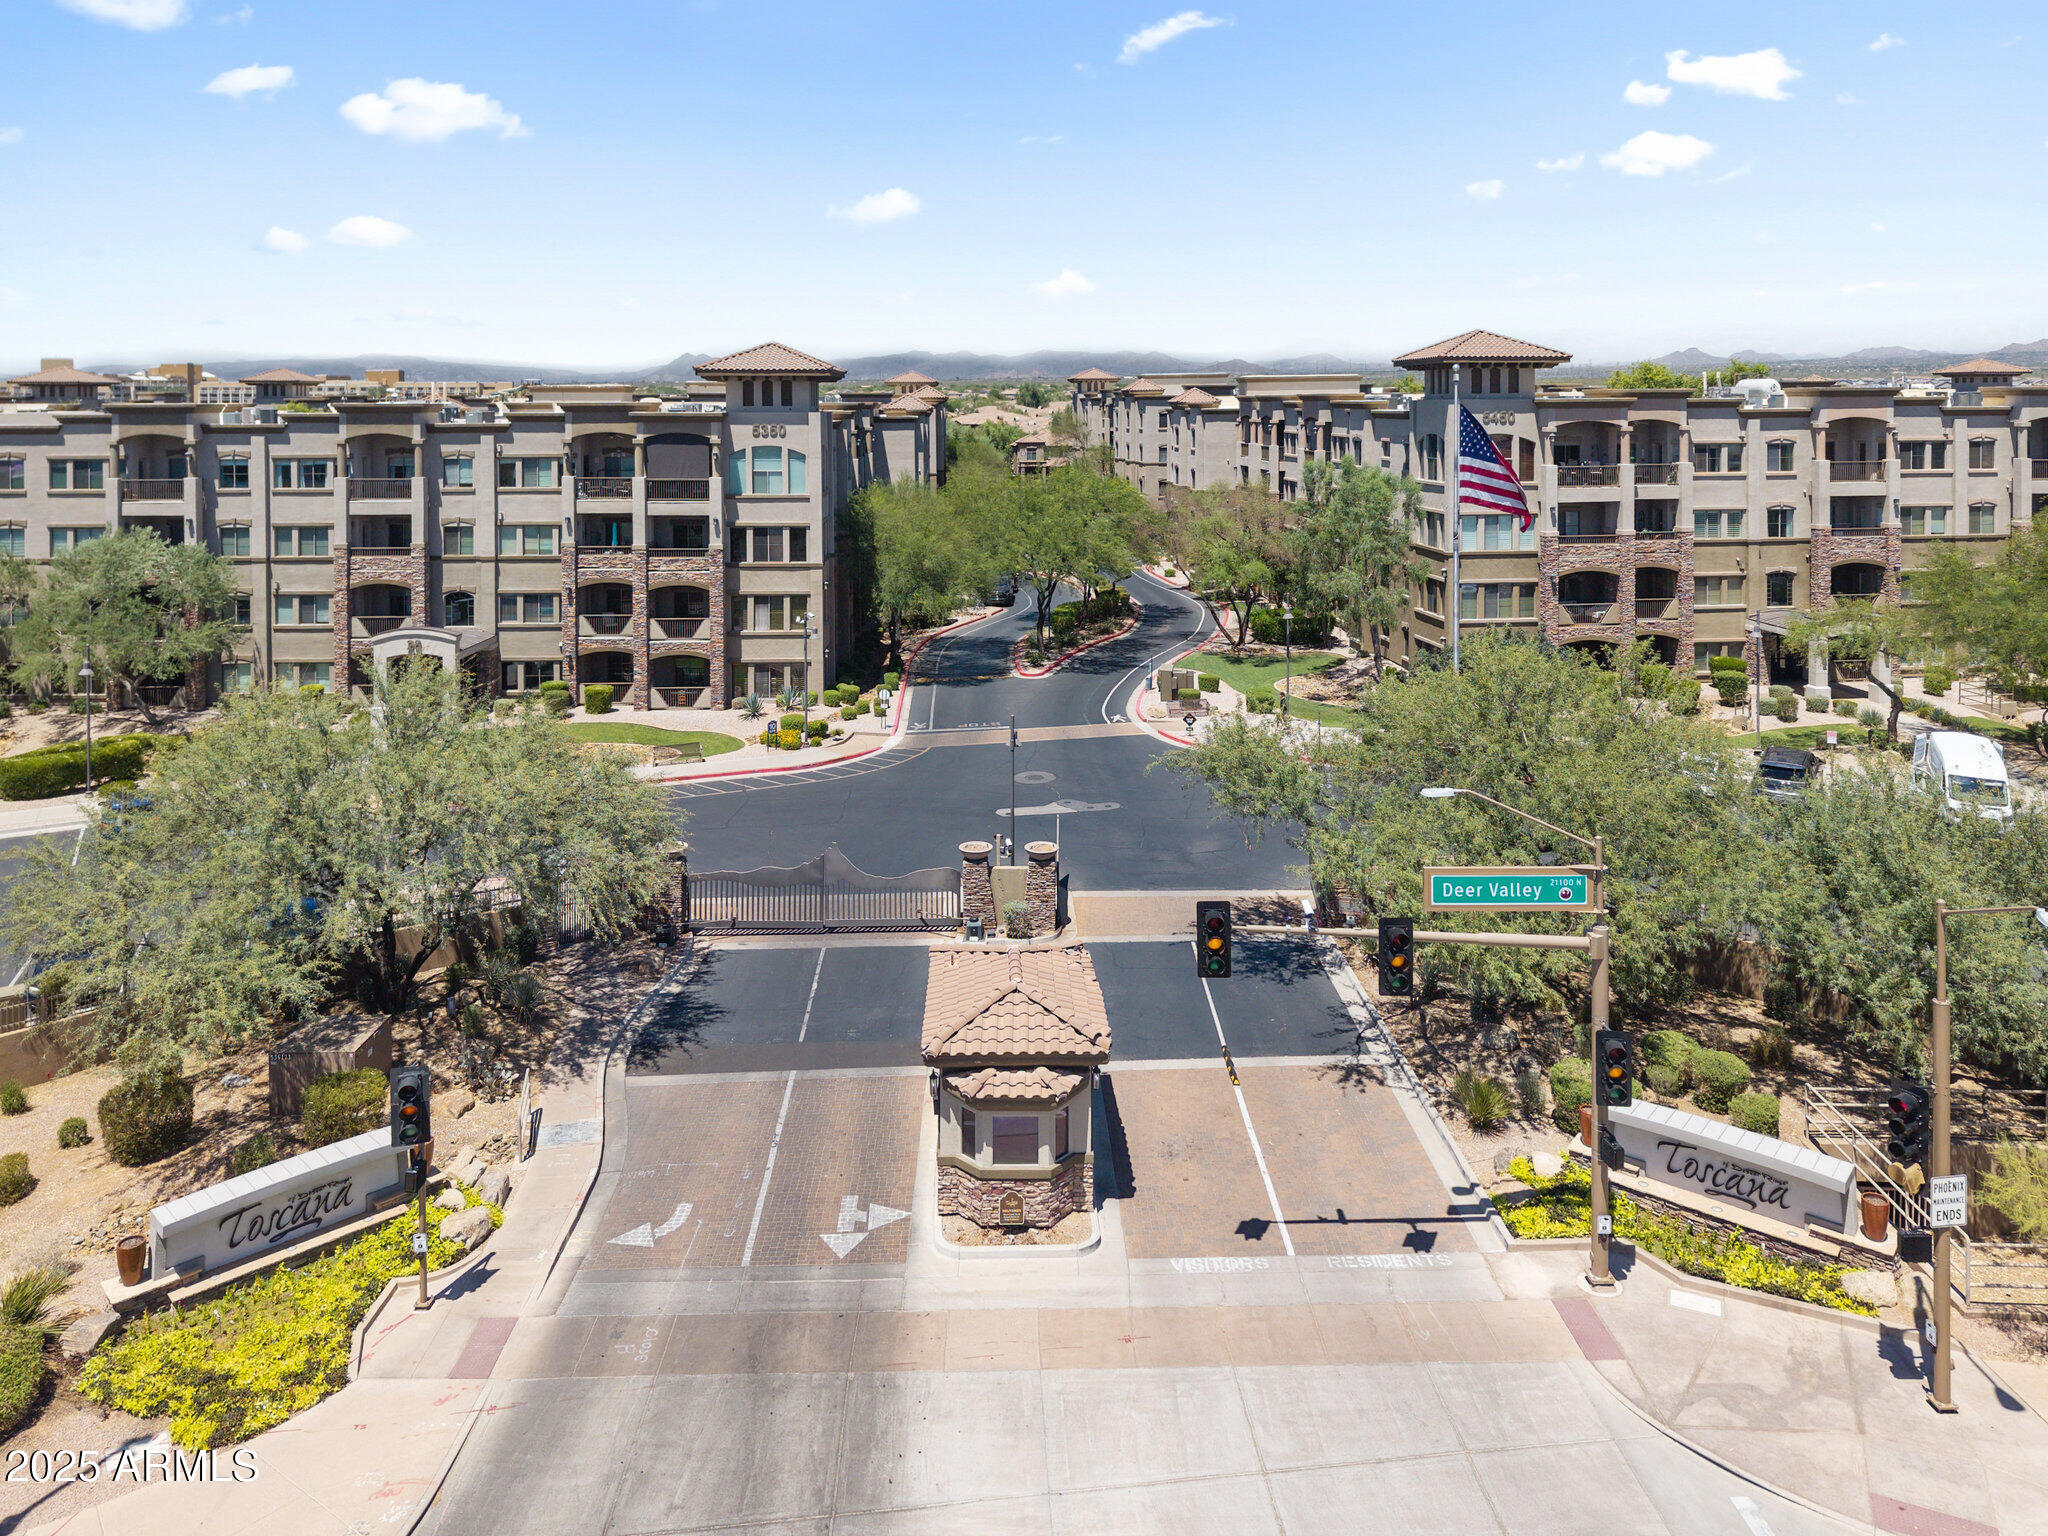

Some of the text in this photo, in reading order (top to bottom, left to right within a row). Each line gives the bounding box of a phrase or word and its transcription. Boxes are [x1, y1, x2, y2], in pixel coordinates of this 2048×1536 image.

[1443, 883, 1542, 901] Deer Valley
[1657, 1141, 1791, 1209] Toscana
[1933, 1181, 1965, 1193] PHOENIX
[219, 1182, 354, 1248] Toscana
[1936, 1209, 1962, 1221] ENDS
[1169, 1256, 1269, 1273] VISITORS
[1326, 1252, 1453, 1268] RESIDENTS
